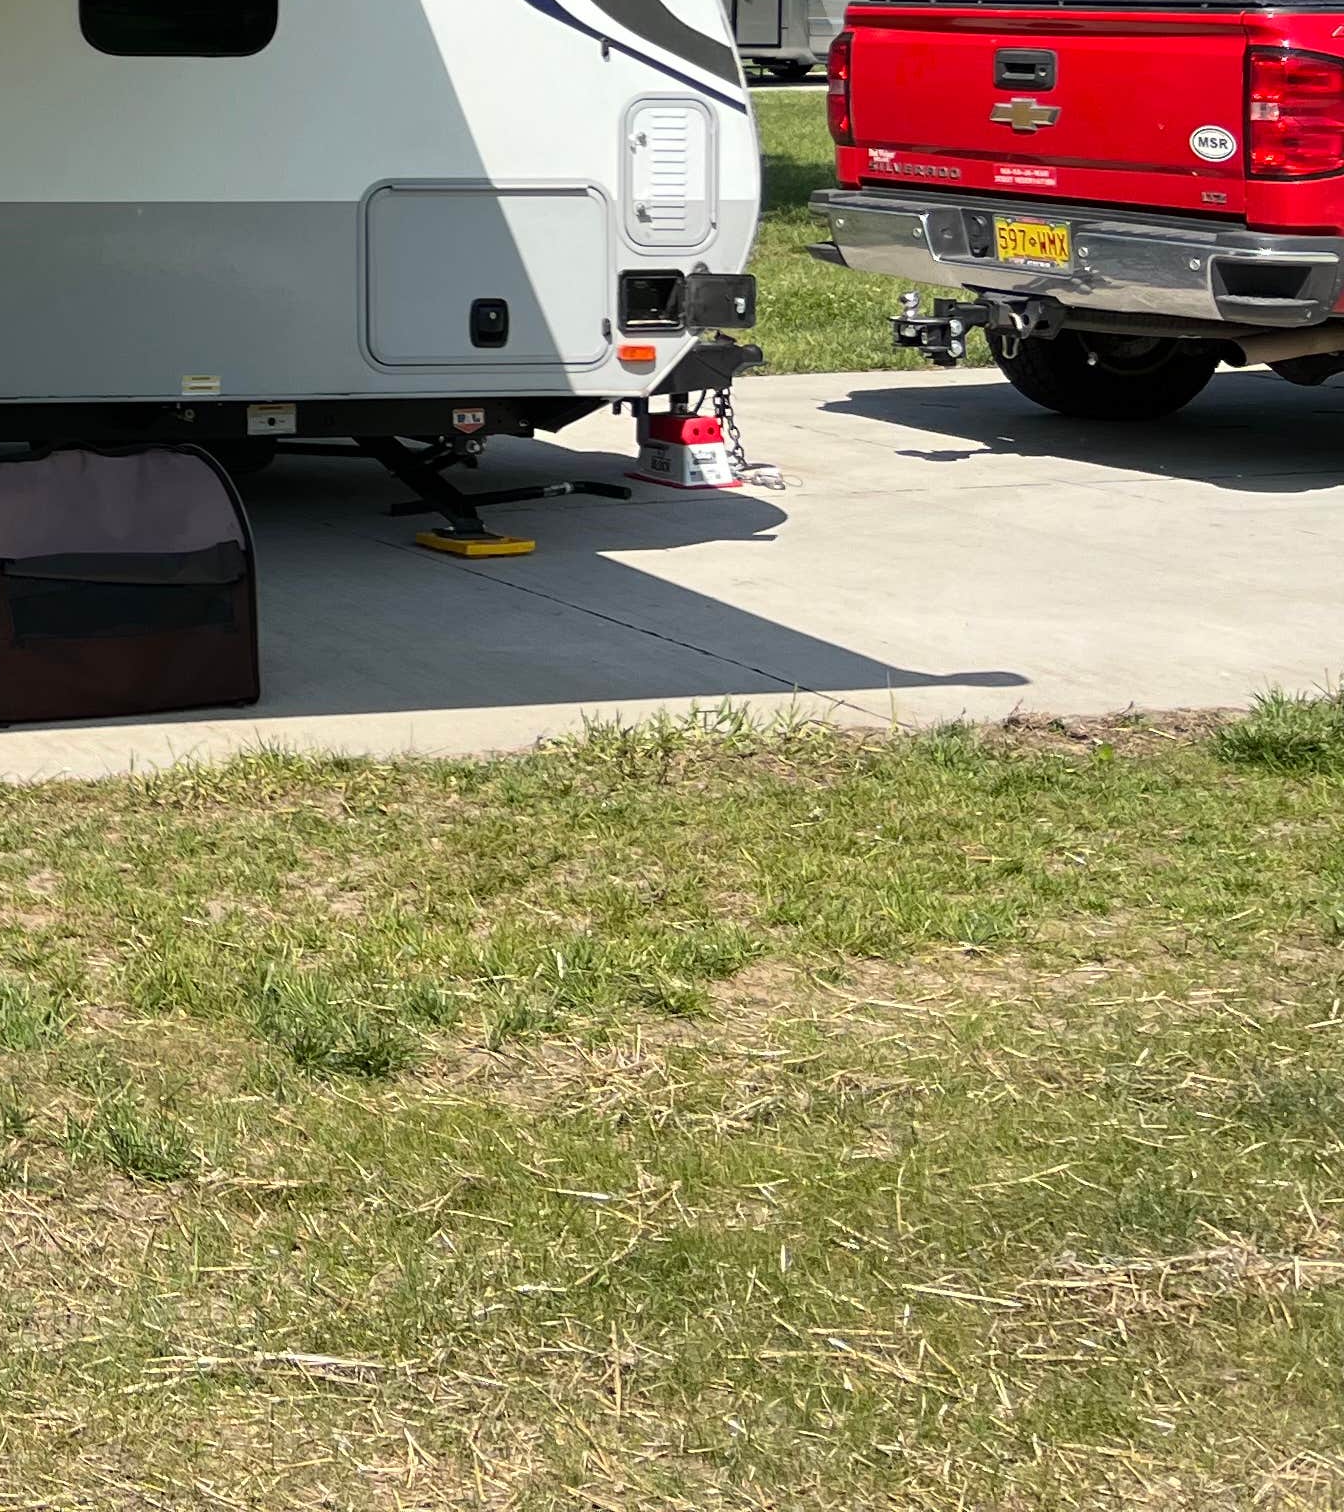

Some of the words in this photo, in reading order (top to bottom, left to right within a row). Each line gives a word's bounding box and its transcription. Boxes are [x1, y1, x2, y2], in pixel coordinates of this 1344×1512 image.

[1198, 137, 1228, 149] MSR
[868, 159, 962, 179] SILVERADO
[999, 227, 1026, 252] 597
